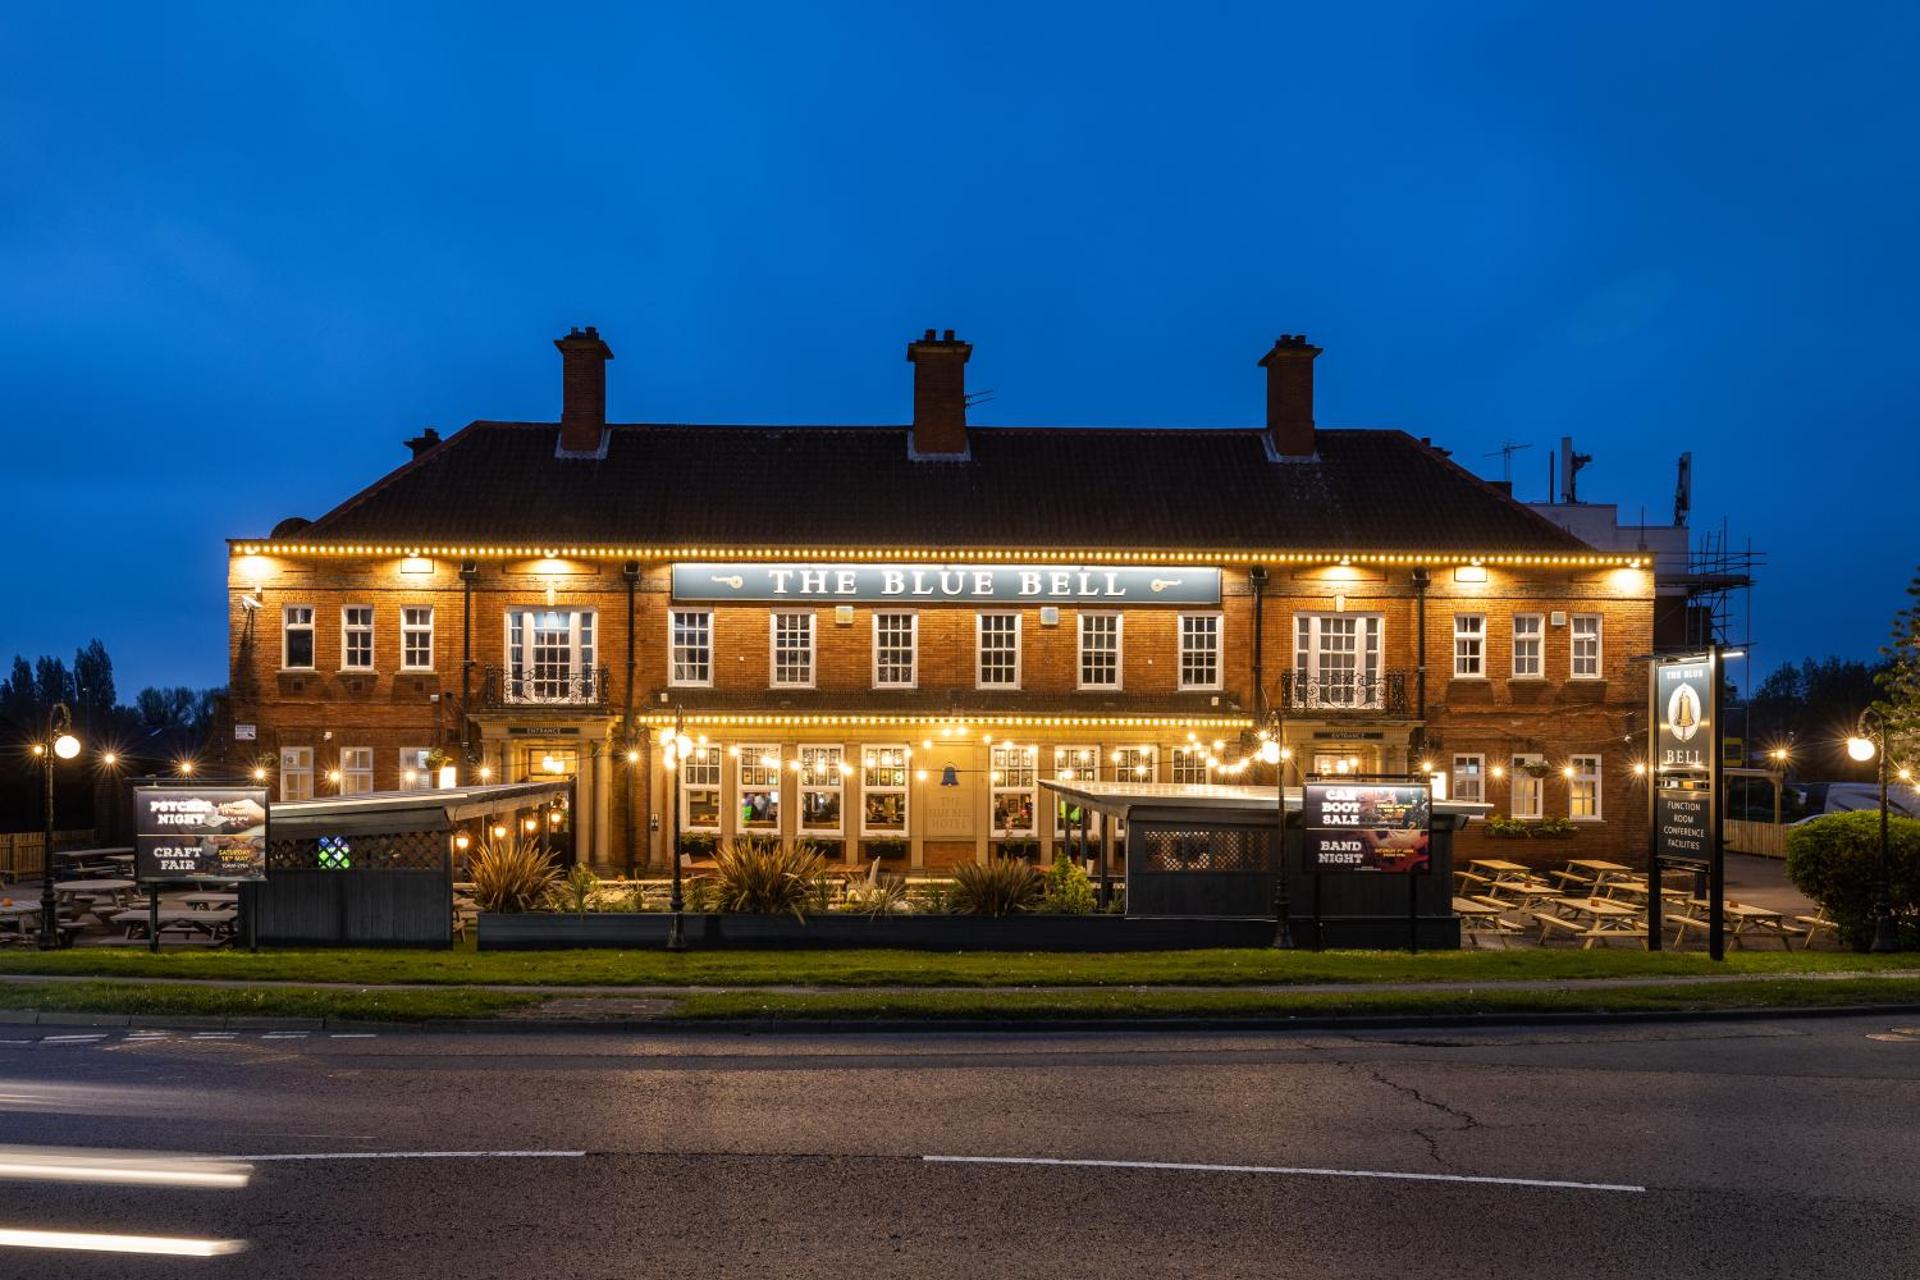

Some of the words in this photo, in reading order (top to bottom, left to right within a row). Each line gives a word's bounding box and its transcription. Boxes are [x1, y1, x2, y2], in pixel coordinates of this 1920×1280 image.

[768, 569, 858, 594] THE
[881, 570, 994, 596] BLUE
[1018, 571, 1126, 597] BELL
[1667, 671, 1681, 679] THE
[1684, 669, 1703, 678] BLUE
[1667, 750, 1702, 764] BELL
[1326, 789, 1357, 800] CAR
[1322, 802, 1360, 812] BOOT
[1667, 801, 1701, 811] FUNCTION
[158, 814, 206, 825] NIGHT
[1323, 814, 1359, 825] SALE
[1674, 814, 1694, 823] ROOM
[1663, 826, 1705, 838] CONFERENCE
[1321, 841, 1361, 851] BAND
[1667, 839, 1700, 850] FACILITIES
[153, 847, 202, 858] CRAFT
[1319, 854, 1363, 863] NIGHT
[161, 860, 195, 870] FAIR
